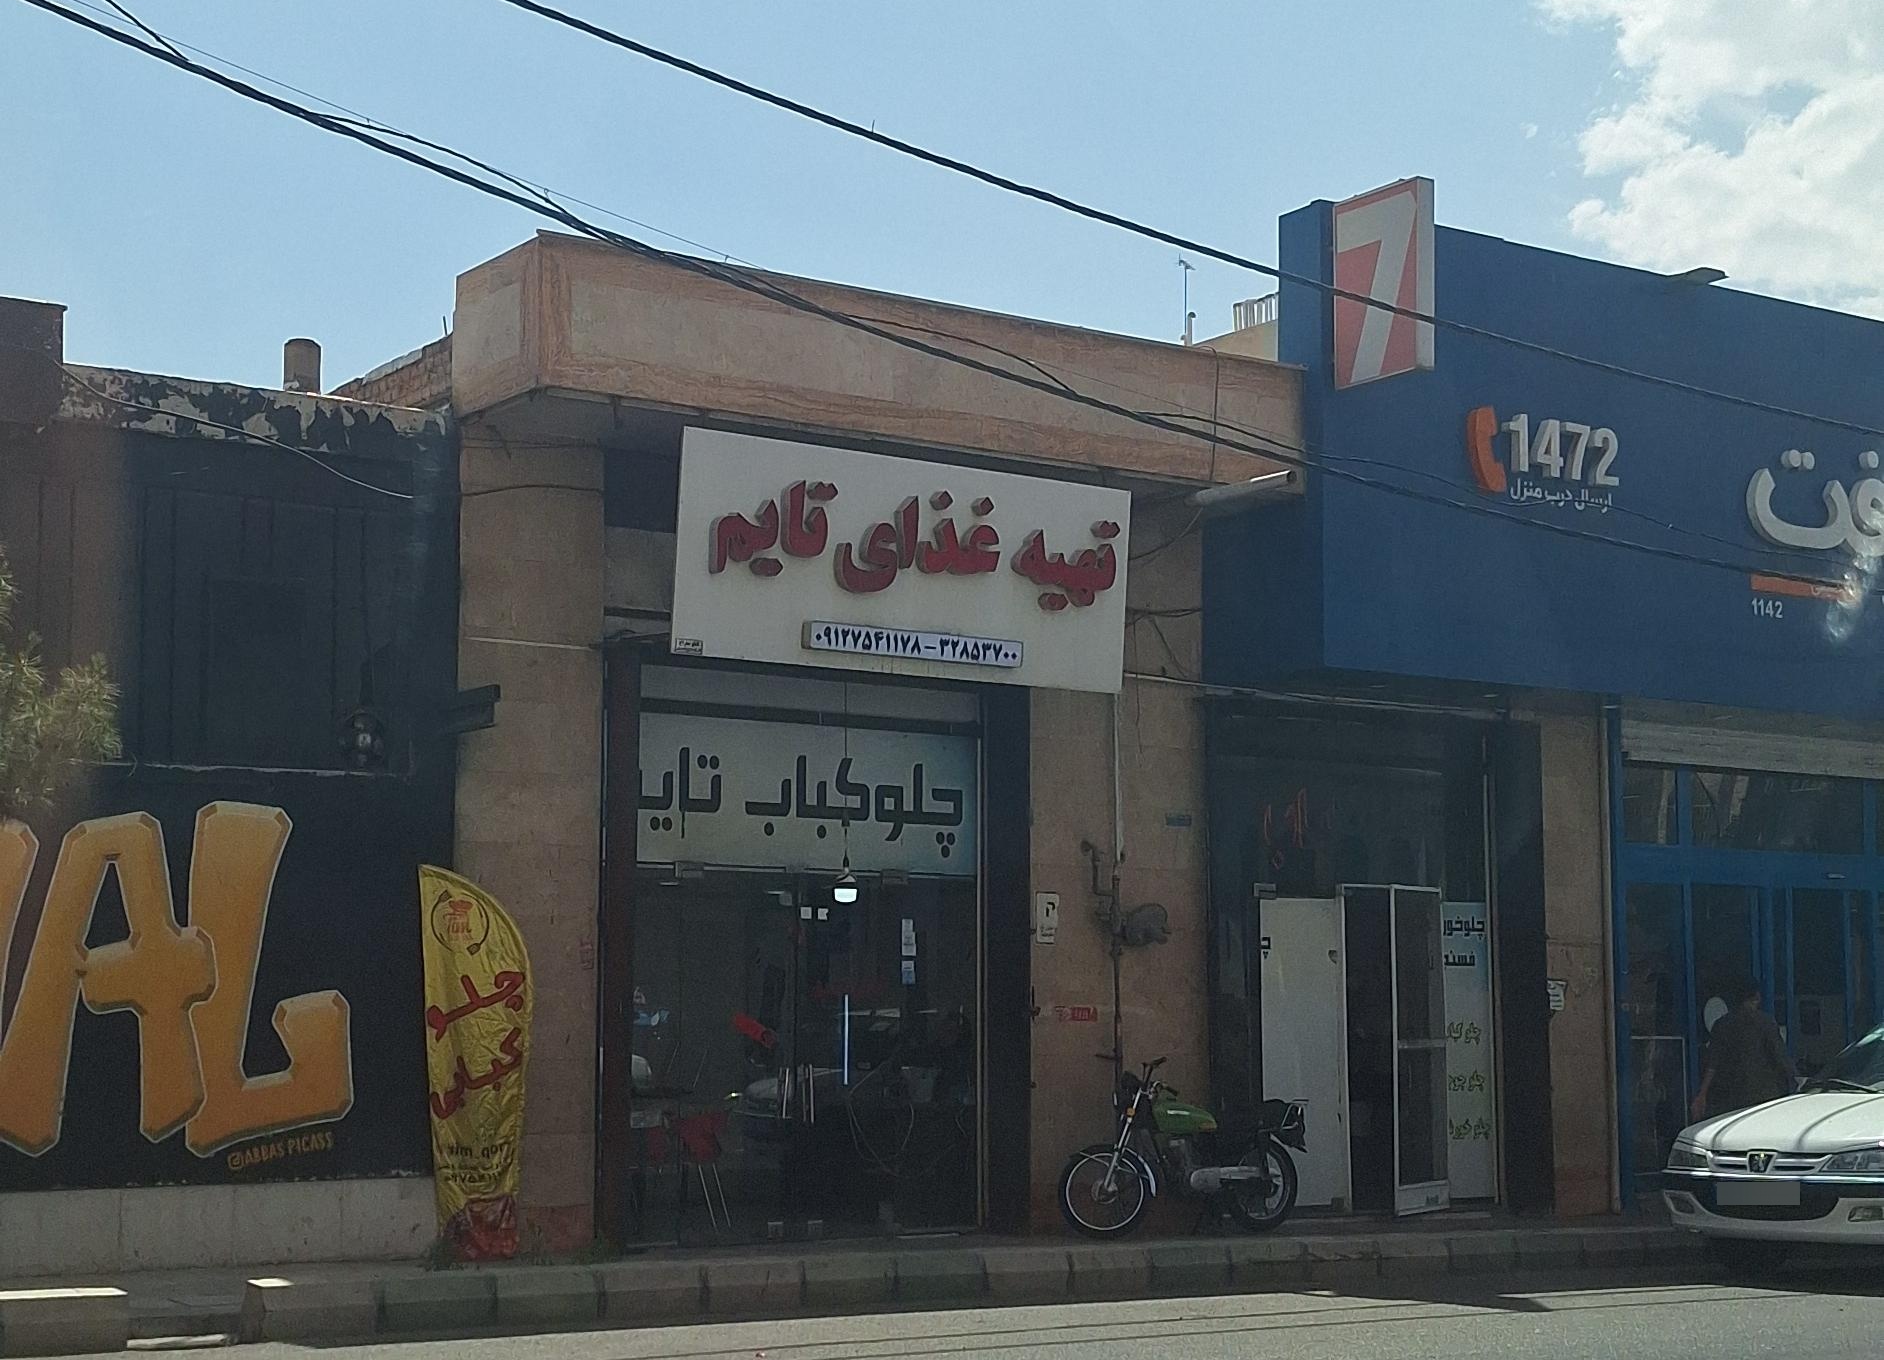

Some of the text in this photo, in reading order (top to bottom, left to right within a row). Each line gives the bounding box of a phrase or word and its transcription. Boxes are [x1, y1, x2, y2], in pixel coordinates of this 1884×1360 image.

[1501, 413, 1620, 487] 1472
[1510, 477, 1612, 514] ارسال درب منزل
[1746, 448, 1884, 558] فت
[708, 480, 1121, 612] تهیه غذای تایم
[1751, 597, 1783, 619] 1142
[744, 753, 964, 859] چلوکباب
[1443, 915, 1486, 941] چلوخور
[426, 970, 526, 1044] چلو
